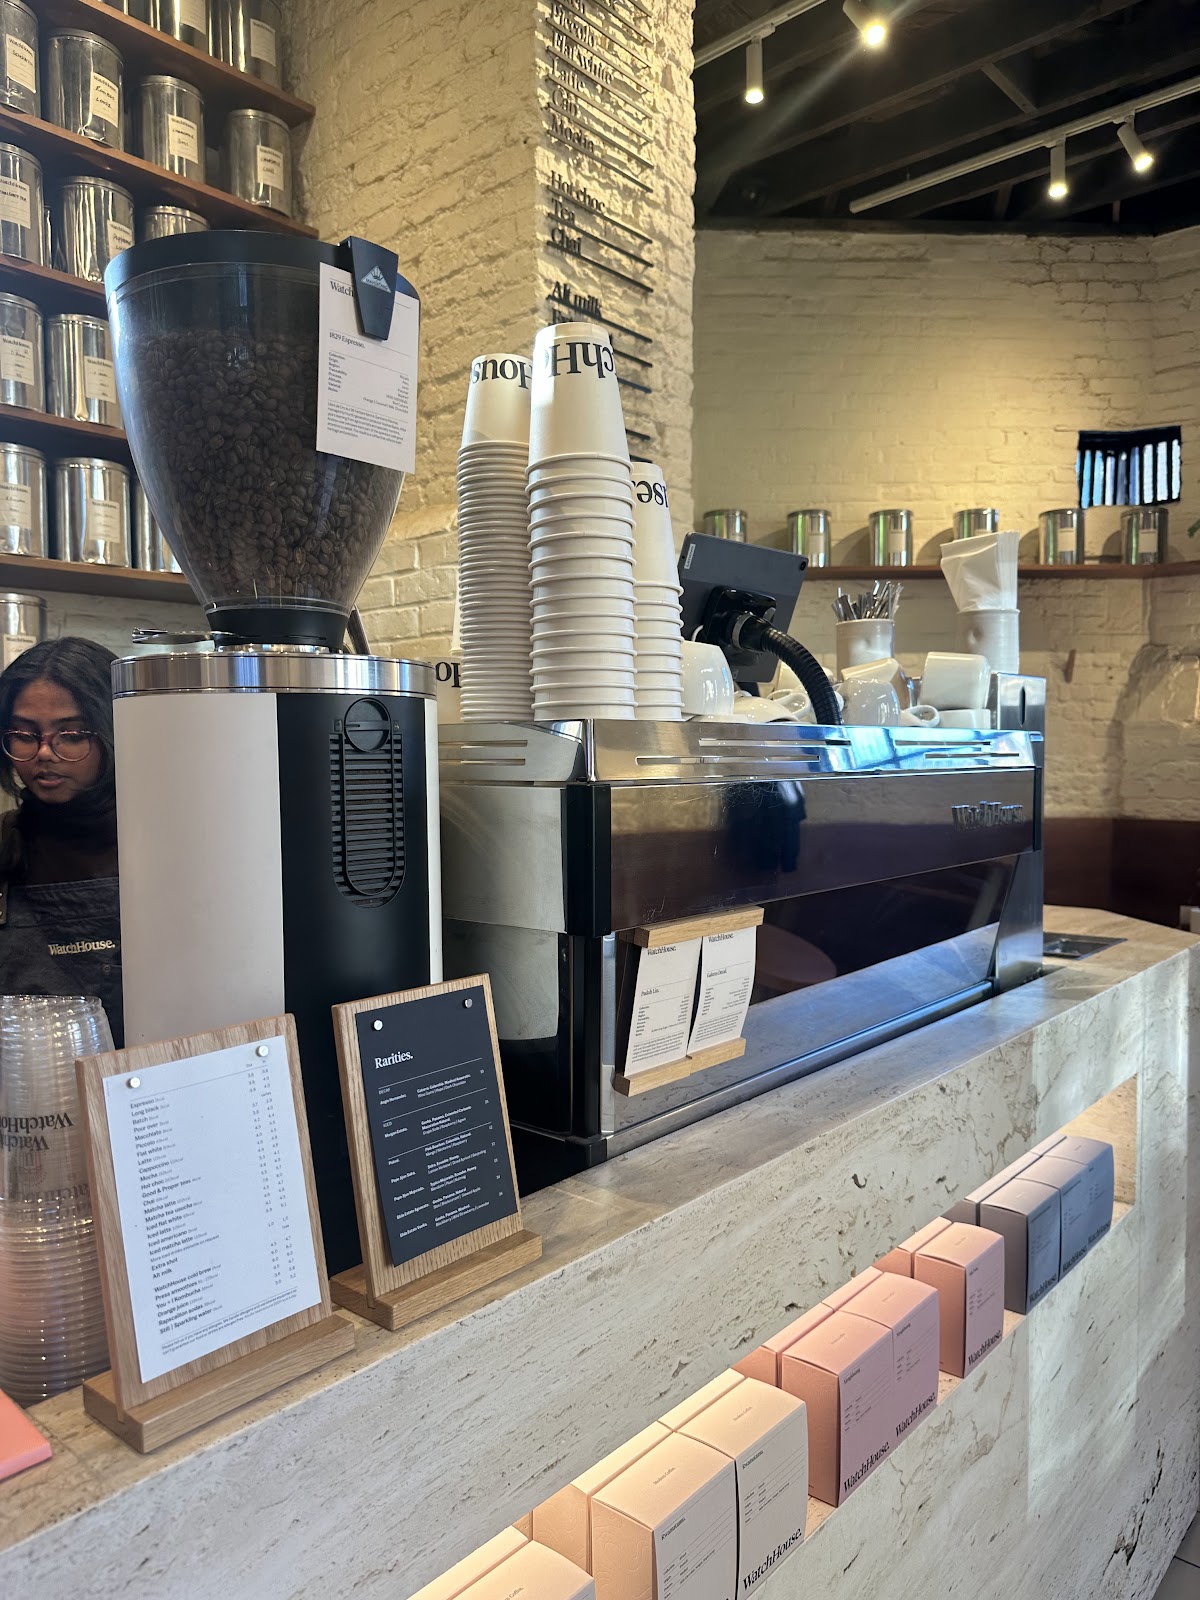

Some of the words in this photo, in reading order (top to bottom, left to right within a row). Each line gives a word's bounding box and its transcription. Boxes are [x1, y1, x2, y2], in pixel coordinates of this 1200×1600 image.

[551, 2, 597, 48] Piccolo
[552, 30, 576, 60] Flat
[576, 46, 614, 85] White
[552, 58, 586, 92] Latte
[551, 113, 594, 152] Mocha
[551, 170, 574, 195] Hot
[576, 187, 605, 212] choc
[551, 198, 575, 226] Tea
[552, 227, 581, 256] Chai
[330, 280, 354, 297] Watch
[552, 281, 571, 302] Alt
[329, 332, 341, 340] 1829
[342, 336, 366, 348] Espresso.
[48, 938, 116, 956] WatchHouse.
[375, 1051, 414, 1069] Rarities.
[130, 1099, 154, 1108] Espresso
[144, 1105, 158, 1113] black
[132, 1116, 148, 1124] Batch
[134, 1130, 161, 1140] Macchiato
[135, 1140, 155, 1149] Piccolo
[147, 1146, 162, 1154] white
[138, 1161, 169, 1173] Cappuccino
[139, 1173, 157, 1181] Mocha
[142, 1189, 156, 1198] Good
[162, 1183, 179, 1191] Proper
[143, 1198, 154, 1206] Chai
[144, 1205, 163, 1214] Matcha
[145, 1213, 164, 1222] Matcha
[168, 1215, 182, 1223] white
[148, 1239, 159, 1247] Iced
[160, 1231, 187, 1242] americano
[161, 1241, 180, 1251] matcha
[151, 1262, 165, 1270] Extra
[166, 1257, 177, 1265] shot
[161, 1267, 172, 1275] milk
[154, 1277, 186, 1292] WatchHouse
[187, 1271, 198, 1279] cold
[198, 1267, 211, 1275] brew
[155, 1292, 170, 1300] Press
[171, 1281, 197, 1294] smoothies
[174, 1288, 200, 1301] Kombucha
[157, 1307, 175, 1317] Orange
[176, 1302, 188, 1310] juice
[188, 1304, 203, 1313] sodas
[159, 1325, 170, 1333] Still
[174, 1315, 197, 1327] Sparkling
[198, 1309, 211, 1317] water
[895, 1392, 936, 1438] WatchHouse.
[844, 1442, 889, 1493] WatchHouse.
[742, 1528, 802, 1590] WatchHouse.
